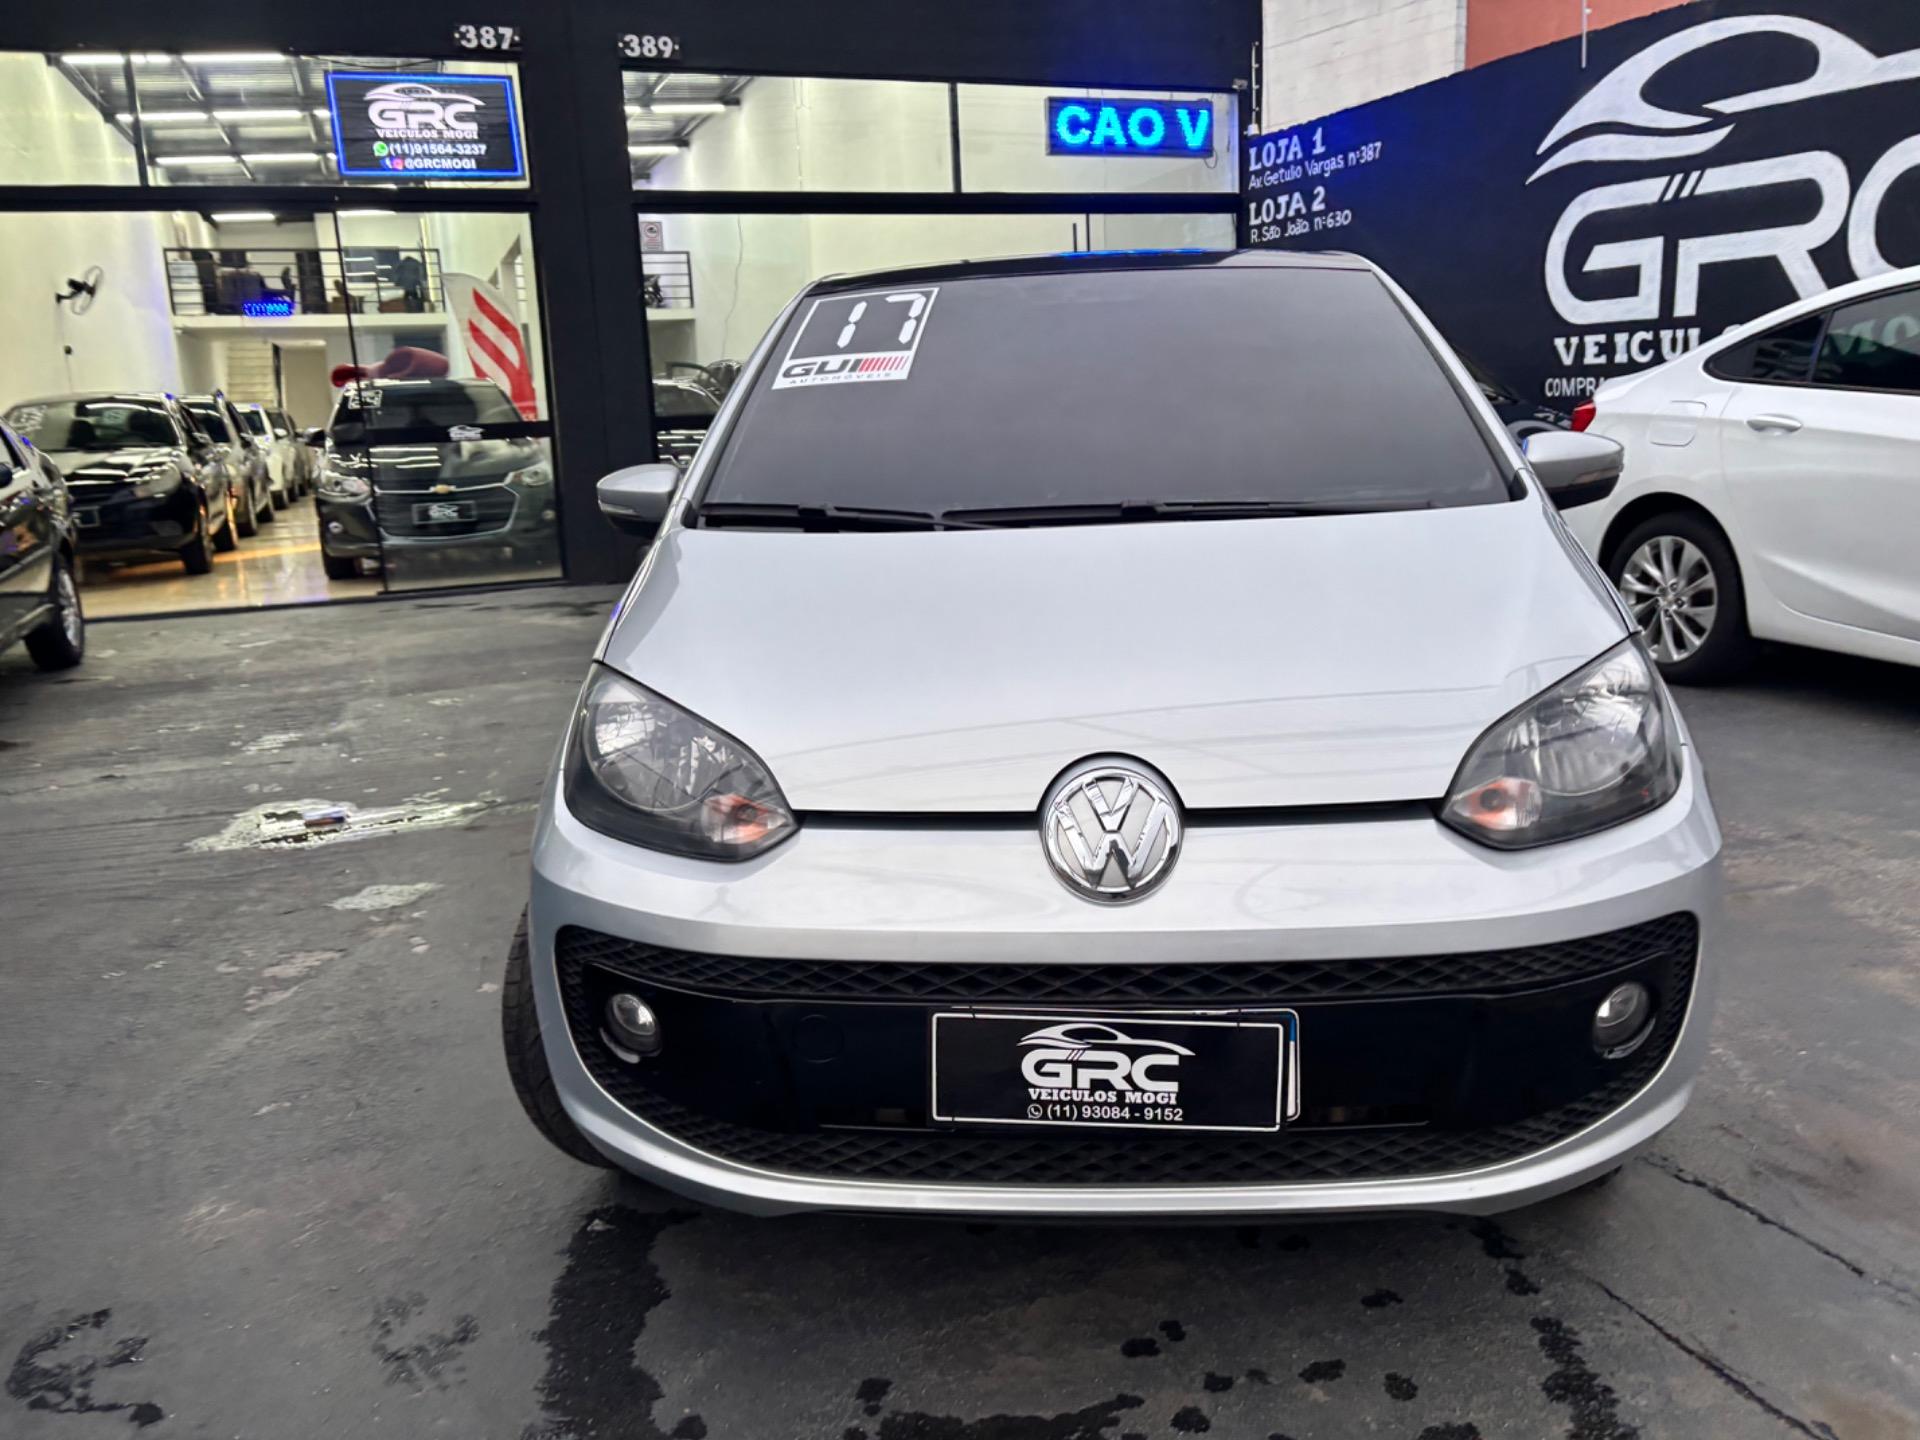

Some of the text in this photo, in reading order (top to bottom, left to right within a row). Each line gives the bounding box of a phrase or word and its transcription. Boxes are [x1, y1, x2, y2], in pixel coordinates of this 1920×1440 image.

[459, 25, 513, 49] 387
[624, 34, 673, 58] 389
[368, 101, 479, 131] GRC
[1176, 108, 1209, 147] V
[443, 129, 478, 139] MOGI
[1249, 127, 1326, 171] LOJA 1
[1249, 186, 1326, 226] LOJA 2
[837, 293, 927, 349] 17
[782, 358, 863, 378] GUI
[1021, 1048, 1180, 1092] GRC
[1028, 1088, 1177, 1105] VEICULOS MOGI
[1047, 1105, 1078, 1120] (11)
[1082, 1105, 1130, 1121] 93084
[1145, 1106, 1183, 1122] 9152
